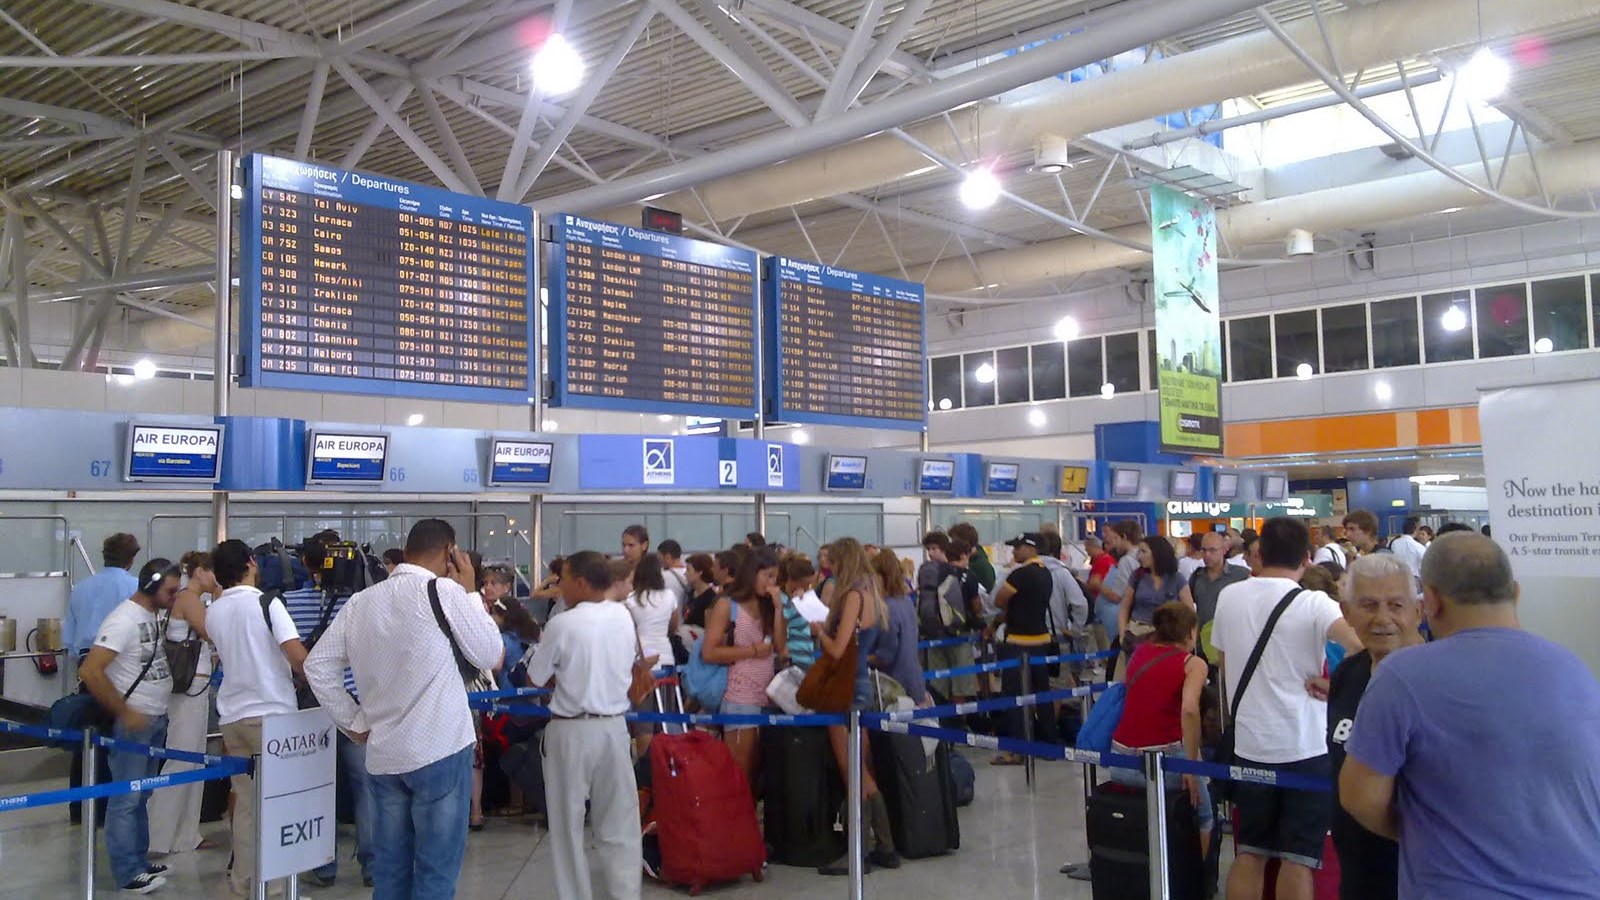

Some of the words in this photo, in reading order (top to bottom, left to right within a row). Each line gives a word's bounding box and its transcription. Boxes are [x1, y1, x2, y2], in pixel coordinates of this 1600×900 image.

[352, 174, 409, 194] Departures
[262, 189, 273, 199] LY
[279, 192, 296, 203] 542
[314, 198, 330, 209] Tel
[336, 202, 357, 214] Aviv
[399, 213, 434, 226] 001-005
[458, 223, 476, 234] 1025
[399, 204, 418, 212] Counter
[262, 204, 273, 215] CY
[279, 207, 296, 218] 323
[314, 213, 352, 227] Larnaca
[399, 227, 434, 240] 051-054
[458, 237, 477, 247] 1035
[262, 220, 273, 230] A3
[279, 223, 296, 234] 930
[314, 228, 341, 240] Cairo
[399, 241, 434, 254] 120-140
[458, 251, 477, 261] 1140
[628, 228, 670, 244] Departures
[279, 238, 296, 249] 752
[314, 243, 341, 255] Samos
[399, 256, 434, 268] 079-100
[458, 264, 477, 274] 1155
[262, 251, 273, 261] CO
[279, 253, 296, 264] 105
[314, 258, 346, 270] Newark
[399, 270, 434, 282] 017-021
[458, 278, 477, 288] 1200
[826, 266, 858, 280] Departures
[313, 273, 362, 287] Thes/niki
[399, 284, 434, 296] 079-101
[458, 292, 477, 301] 1240
[262, 282, 273, 291] A3
[313, 288, 357, 301] Iraklion
[399, 298, 434, 310] 120-142
[458, 305, 477, 315] 1245
[262, 297, 273, 307] CY
[279, 299, 296, 309] 313
[313, 303, 352, 315] Larnaca
[399, 312, 434, 324] 050-054
[458, 319, 477, 328] 1250
[279, 314, 296, 324] 534
[313, 318, 346, 329] Chania
[458, 333, 477, 342] 1250
[313, 333, 357, 345] Ioannina
[399, 341, 434, 352] 079-101
[458, 347, 477, 356] 1300
[261, 344, 273, 353] SK
[279, 345, 302, 355] 7734
[313, 348, 352, 361] Aalborg
[399, 355, 434, 366] 012-013
[458, 360, 477, 370] 1315
[279, 360, 296, 370] 235
[313, 363, 335, 373] Rome
[341, 365, 357, 374] FCO
[399, 370, 434, 380] 079-100
[458, 374, 477, 383] 1330
[136, 434, 158, 444] AIR
[162, 434, 216, 446] EUROPA
[316, 440, 335, 450] AIR
[338, 441, 383, 451] EUROPA
[496, 447, 512, 455] AIR
[514, 448, 550, 456] EUROPA
[90, 460, 111, 476] 67
[390, 468, 405, 481] 66
[464, 468, 477, 482] 65
[724, 463, 733, 482] 2
[1503, 477, 1547, 498] Now
[1552, 483, 1575, 496] the
[1579, 482, 1600, 496] ha
[1508, 504, 1593, 517] destination
[1510, 533, 1528, 542] Our
[1532, 532, 1578, 542] Premium
[1511, 547, 1519, 555] A
[1555, 547, 1589, 555] transit
[1332, 718, 1353, 742] B
[267, 733, 316, 757] QATAR
[140, 776, 169, 785] ATHENS
[1242, 767, 1276, 777] ATHENS
[0, 796, 27, 804] THENS
[280, 816, 324, 846] EXIT
